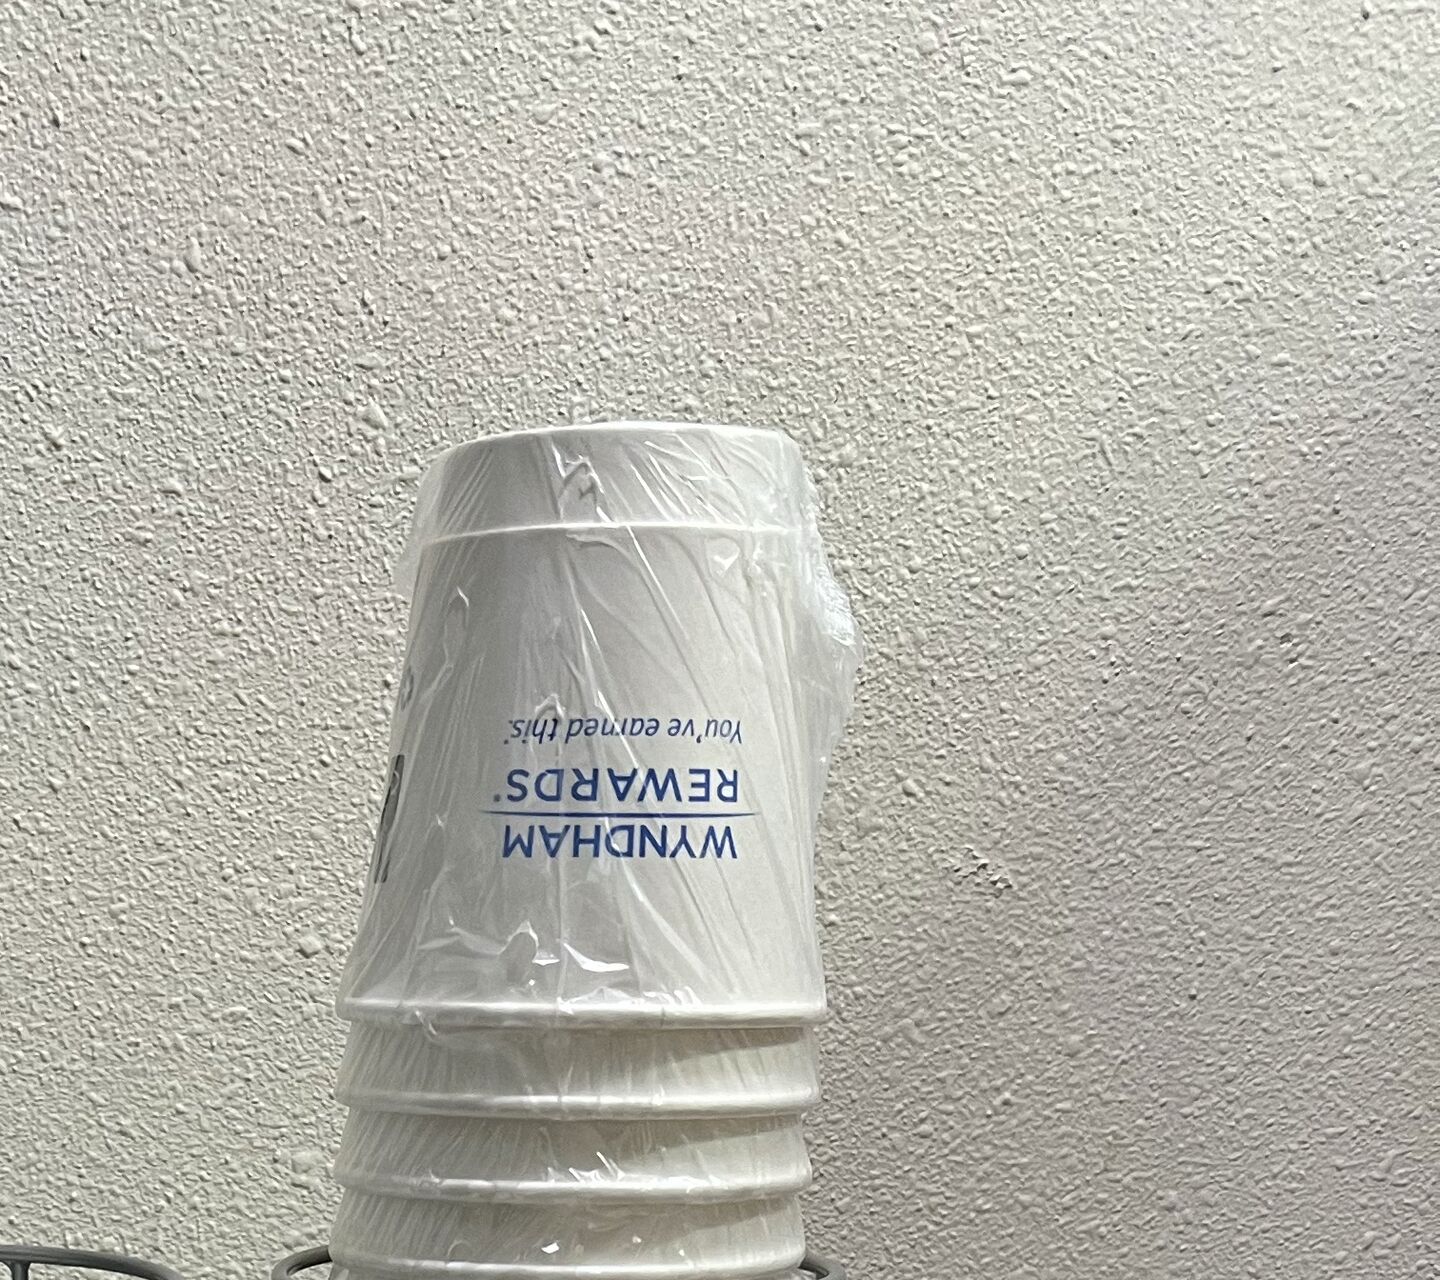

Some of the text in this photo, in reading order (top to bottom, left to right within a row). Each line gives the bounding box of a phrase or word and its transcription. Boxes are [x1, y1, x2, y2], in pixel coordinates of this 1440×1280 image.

[564, 718, 660, 744] earned
[667, 719, 743, 745] You've
[506, 767, 738, 803] REWARDS
[501, 824, 738, 859] WYNDHAM
